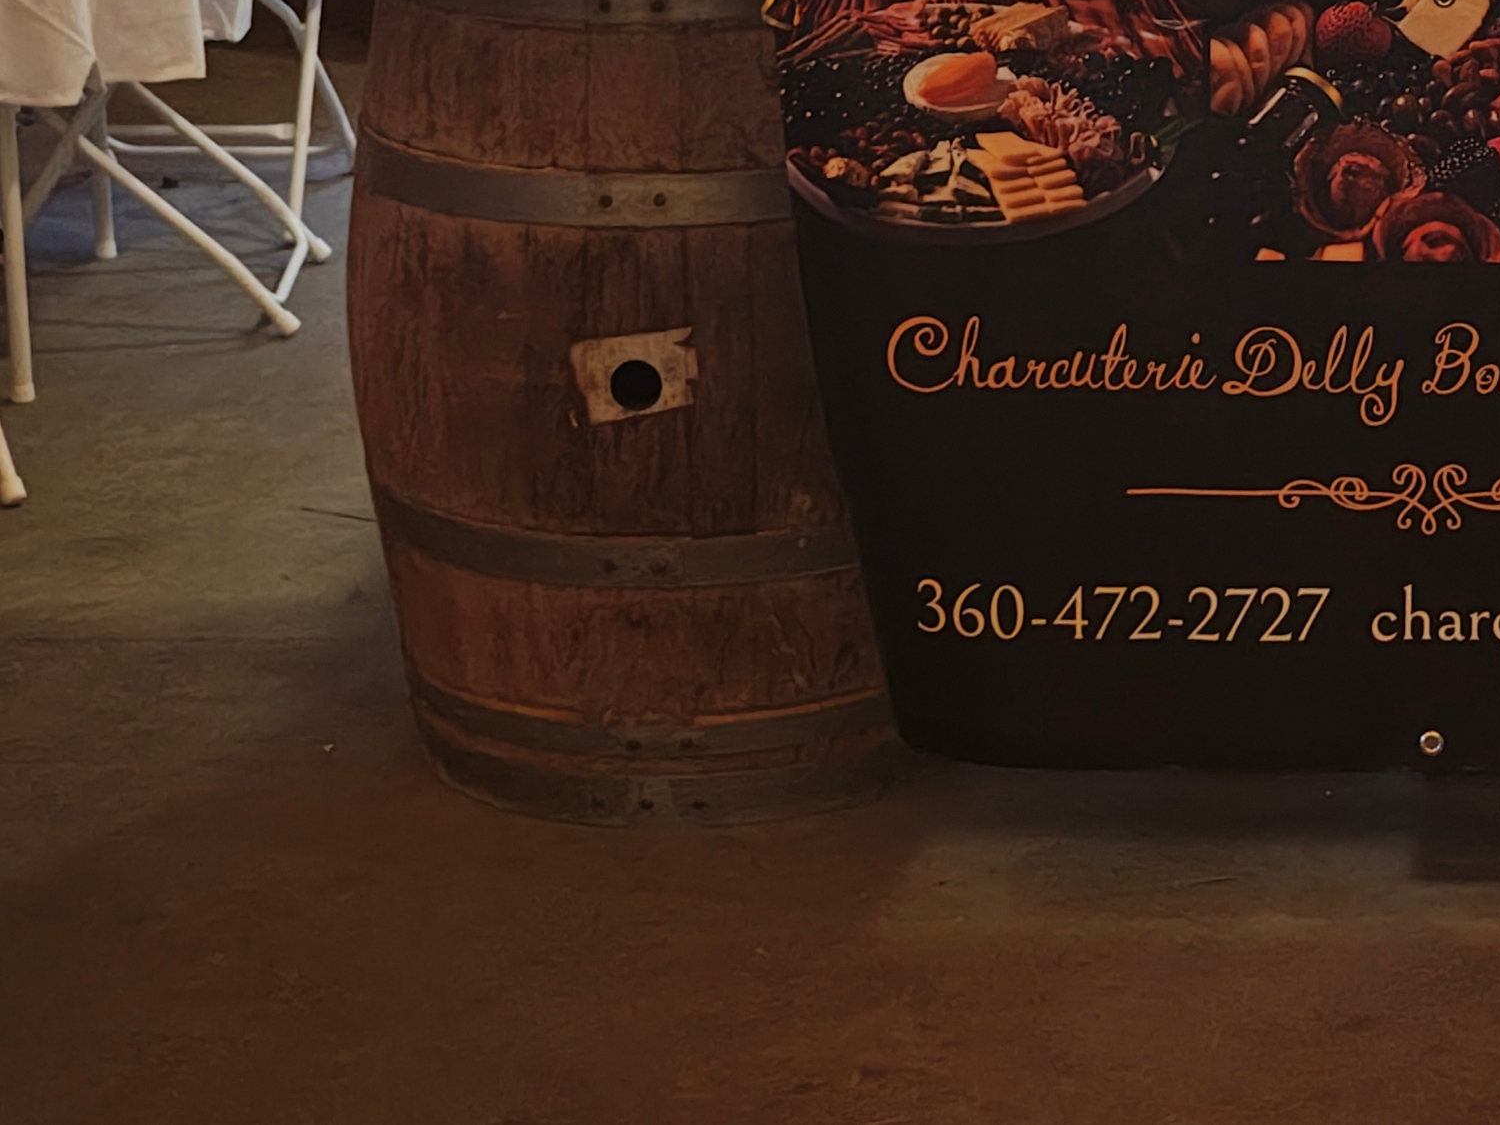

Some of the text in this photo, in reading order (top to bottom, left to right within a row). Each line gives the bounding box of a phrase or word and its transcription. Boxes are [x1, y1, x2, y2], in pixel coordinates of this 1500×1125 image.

[888, 316, 1216, 393] Charcuterie
[1222, 326, 1404, 426] Delly
[918, 579, 1330, 641] 360-472-2727
